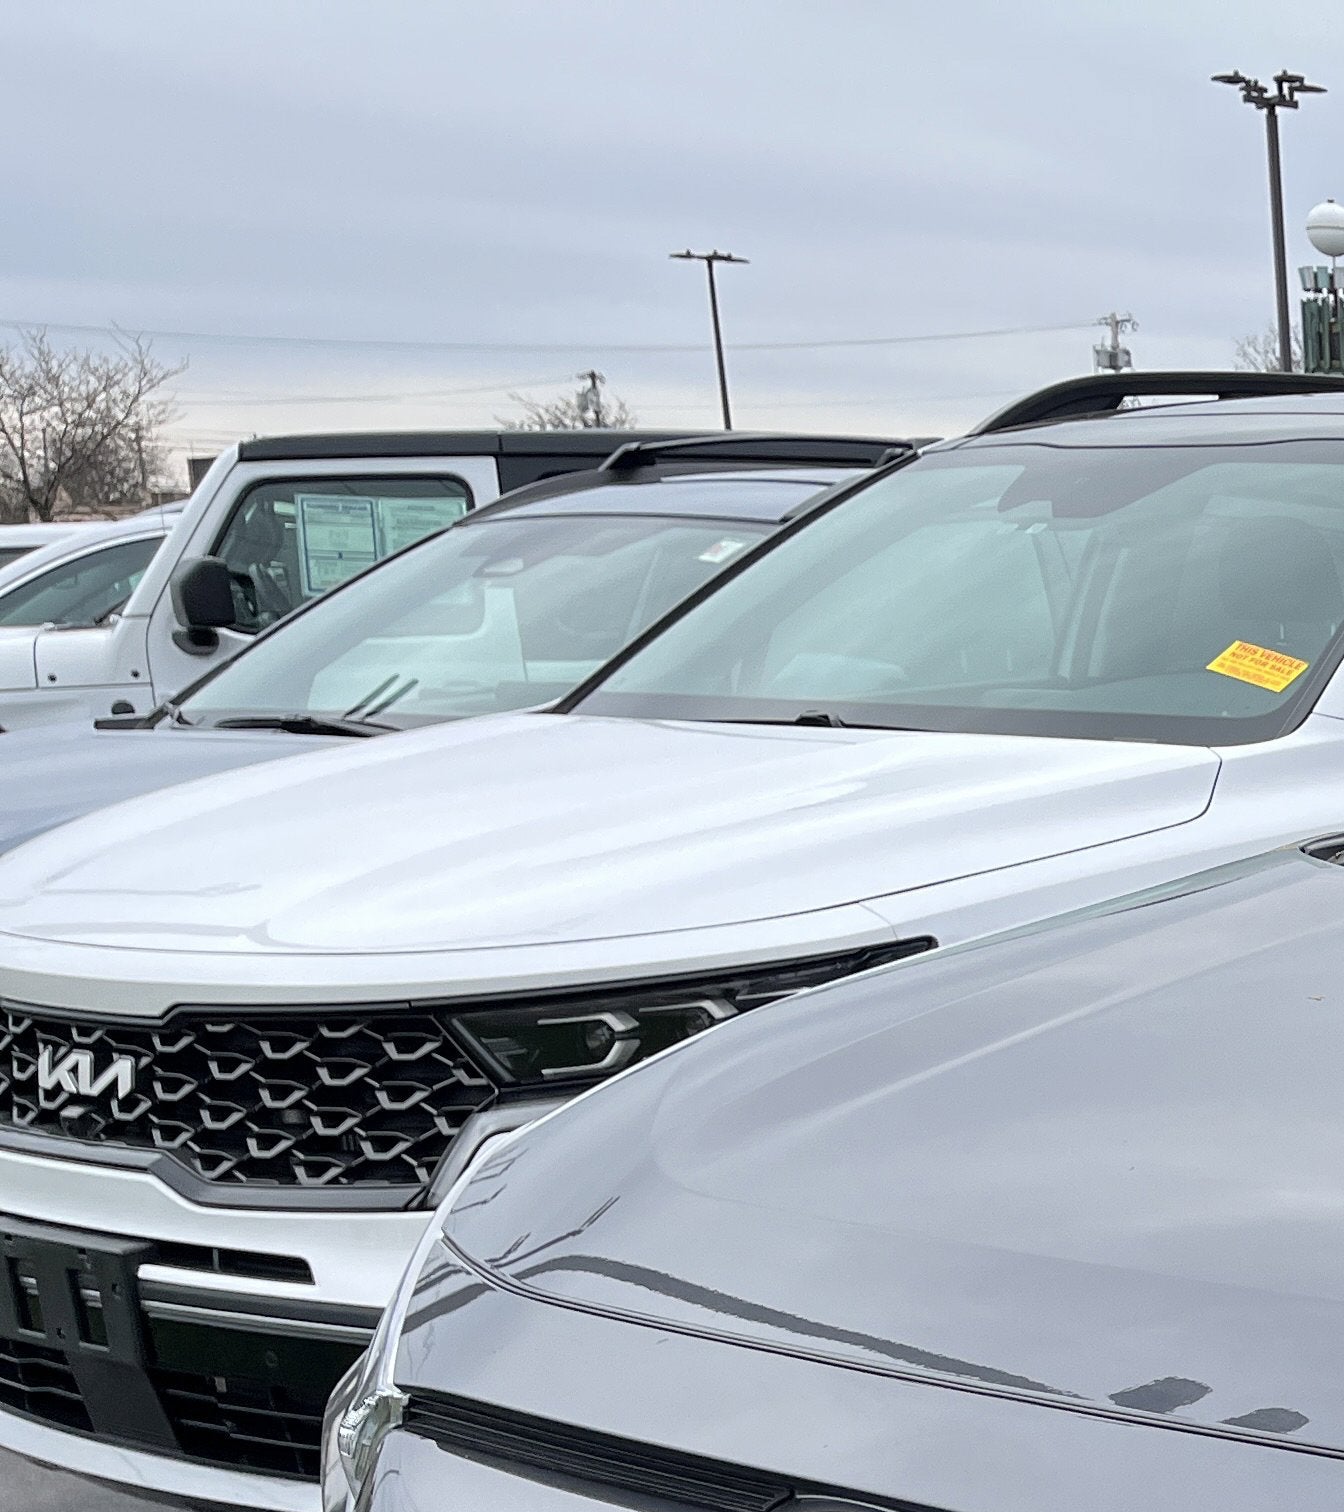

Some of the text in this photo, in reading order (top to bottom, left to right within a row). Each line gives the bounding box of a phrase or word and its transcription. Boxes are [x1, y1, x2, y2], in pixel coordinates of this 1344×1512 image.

[1230, 652, 1247, 661] NOT
[1248, 657, 1269, 668] FOR
[1270, 664, 1294, 675] SALE
[1235, 643, 1258, 655] THIS
[1260, 650, 1304, 670] VEHICLE
[37, 1046, 136, 1100] KIA
